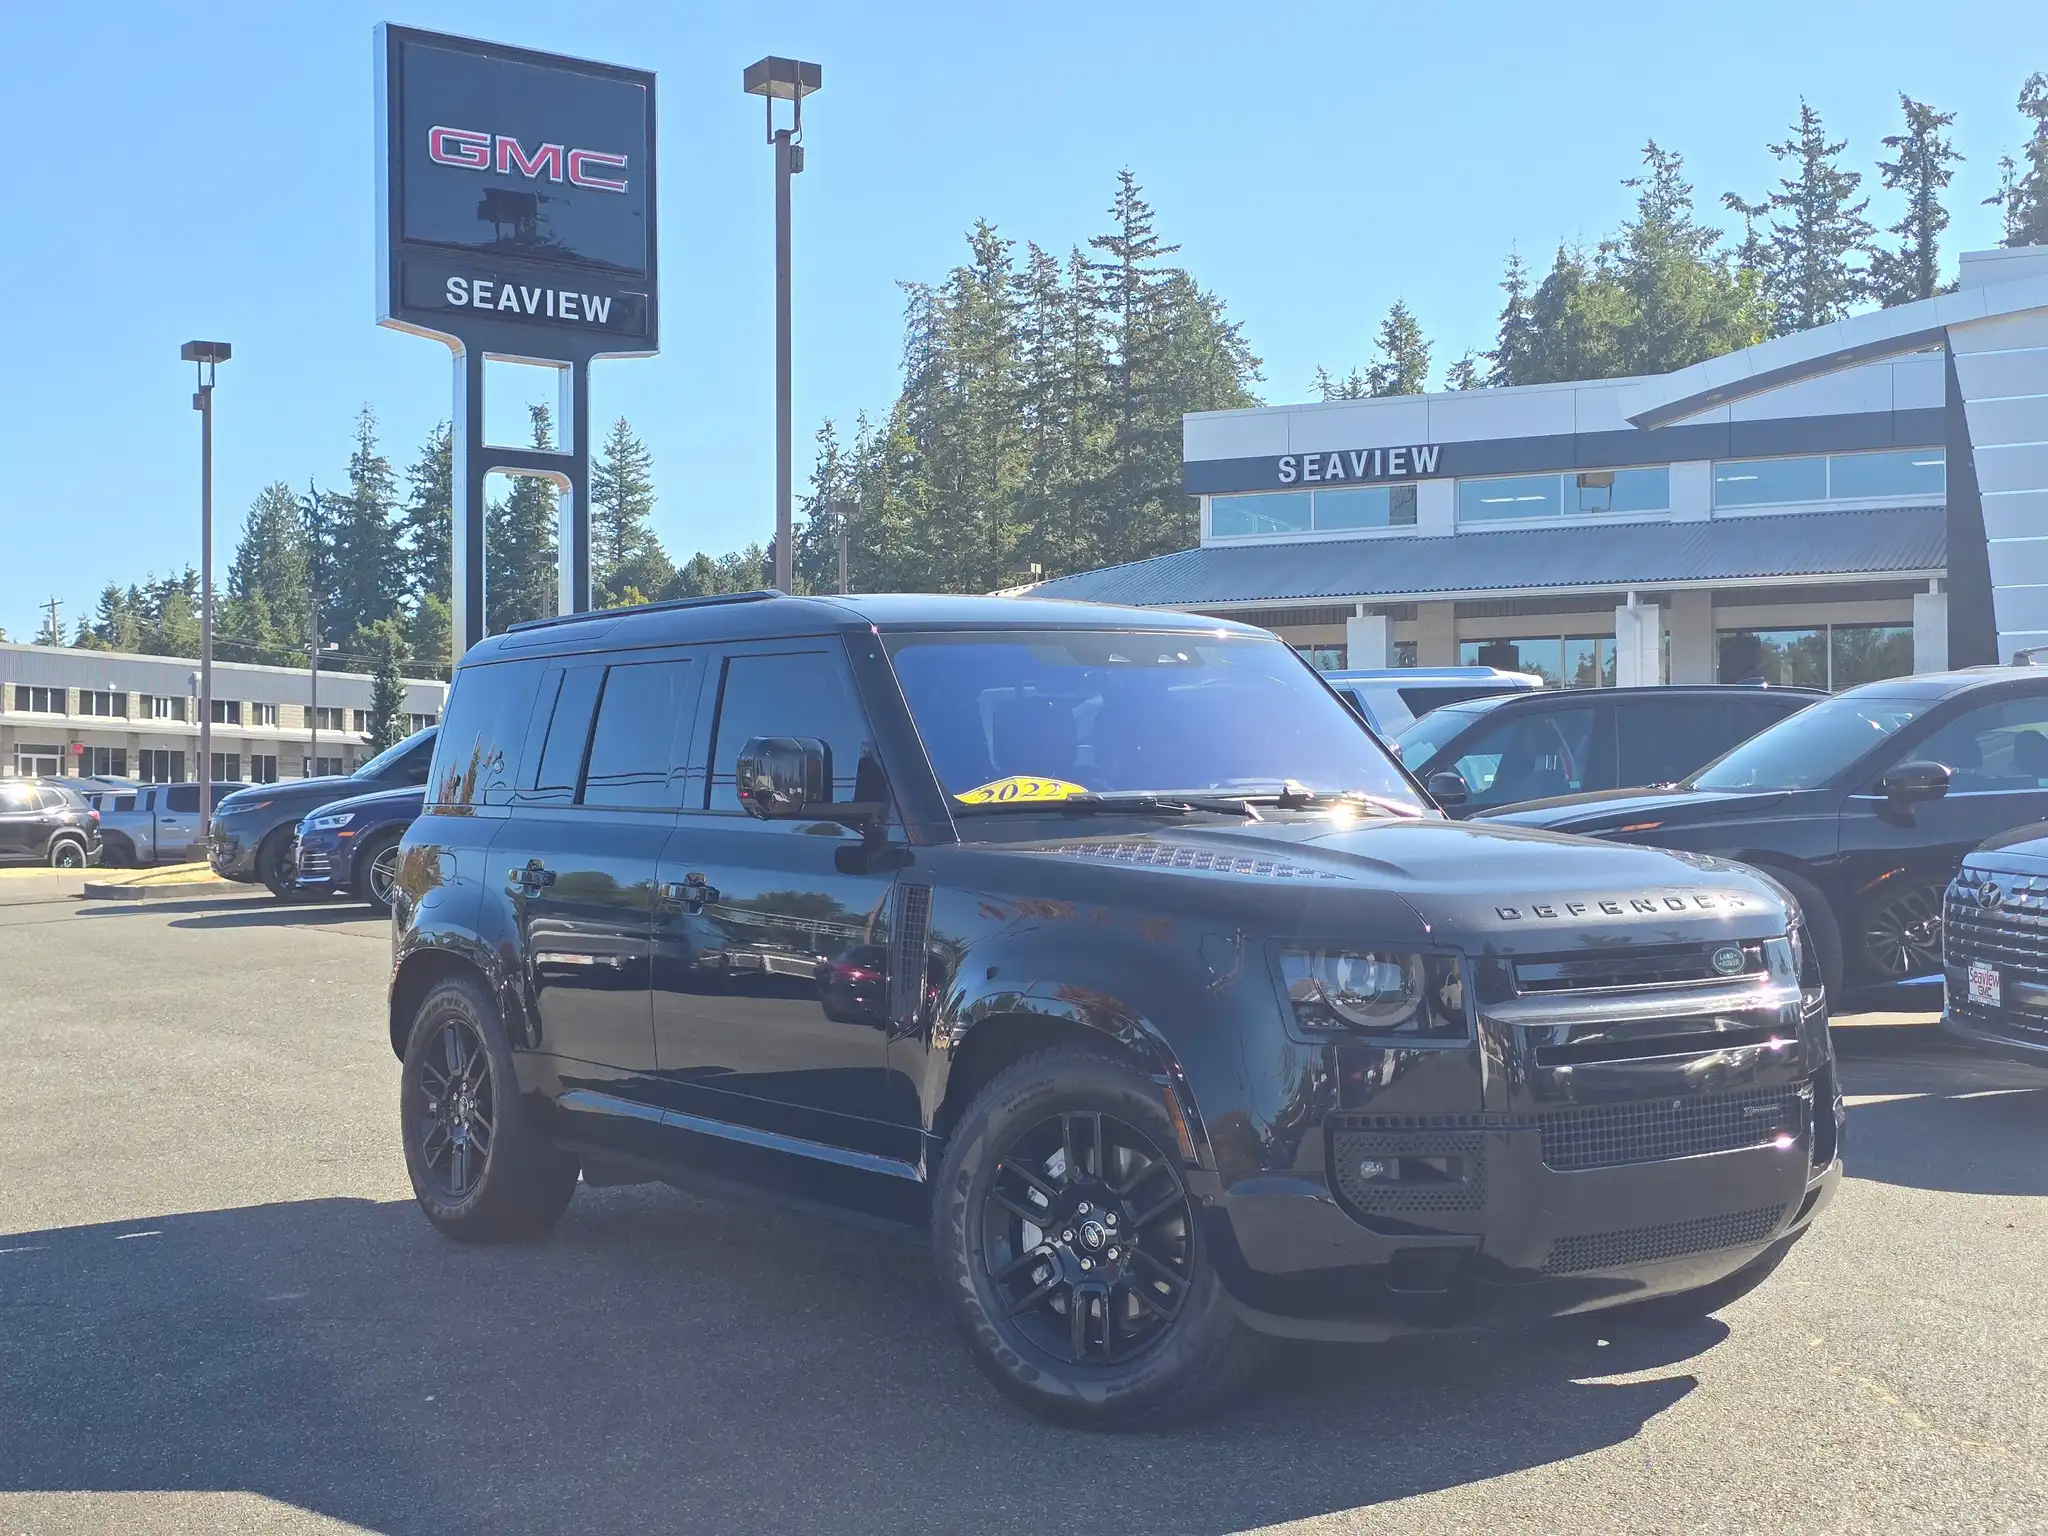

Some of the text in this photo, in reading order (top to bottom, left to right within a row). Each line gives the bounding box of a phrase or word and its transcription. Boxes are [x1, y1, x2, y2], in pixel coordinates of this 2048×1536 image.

[428, 125, 628, 194] GMC
[446, 276, 612, 324] SEAVIEW
[1278, 446, 1440, 483] SEAVIEW
[977, 782, 1062, 803] 2022
[1494, 893, 1746, 921] DEFENDER
[1720, 952, 1735, 960] LAND
[1969, 967, 2000, 988] Seaview
